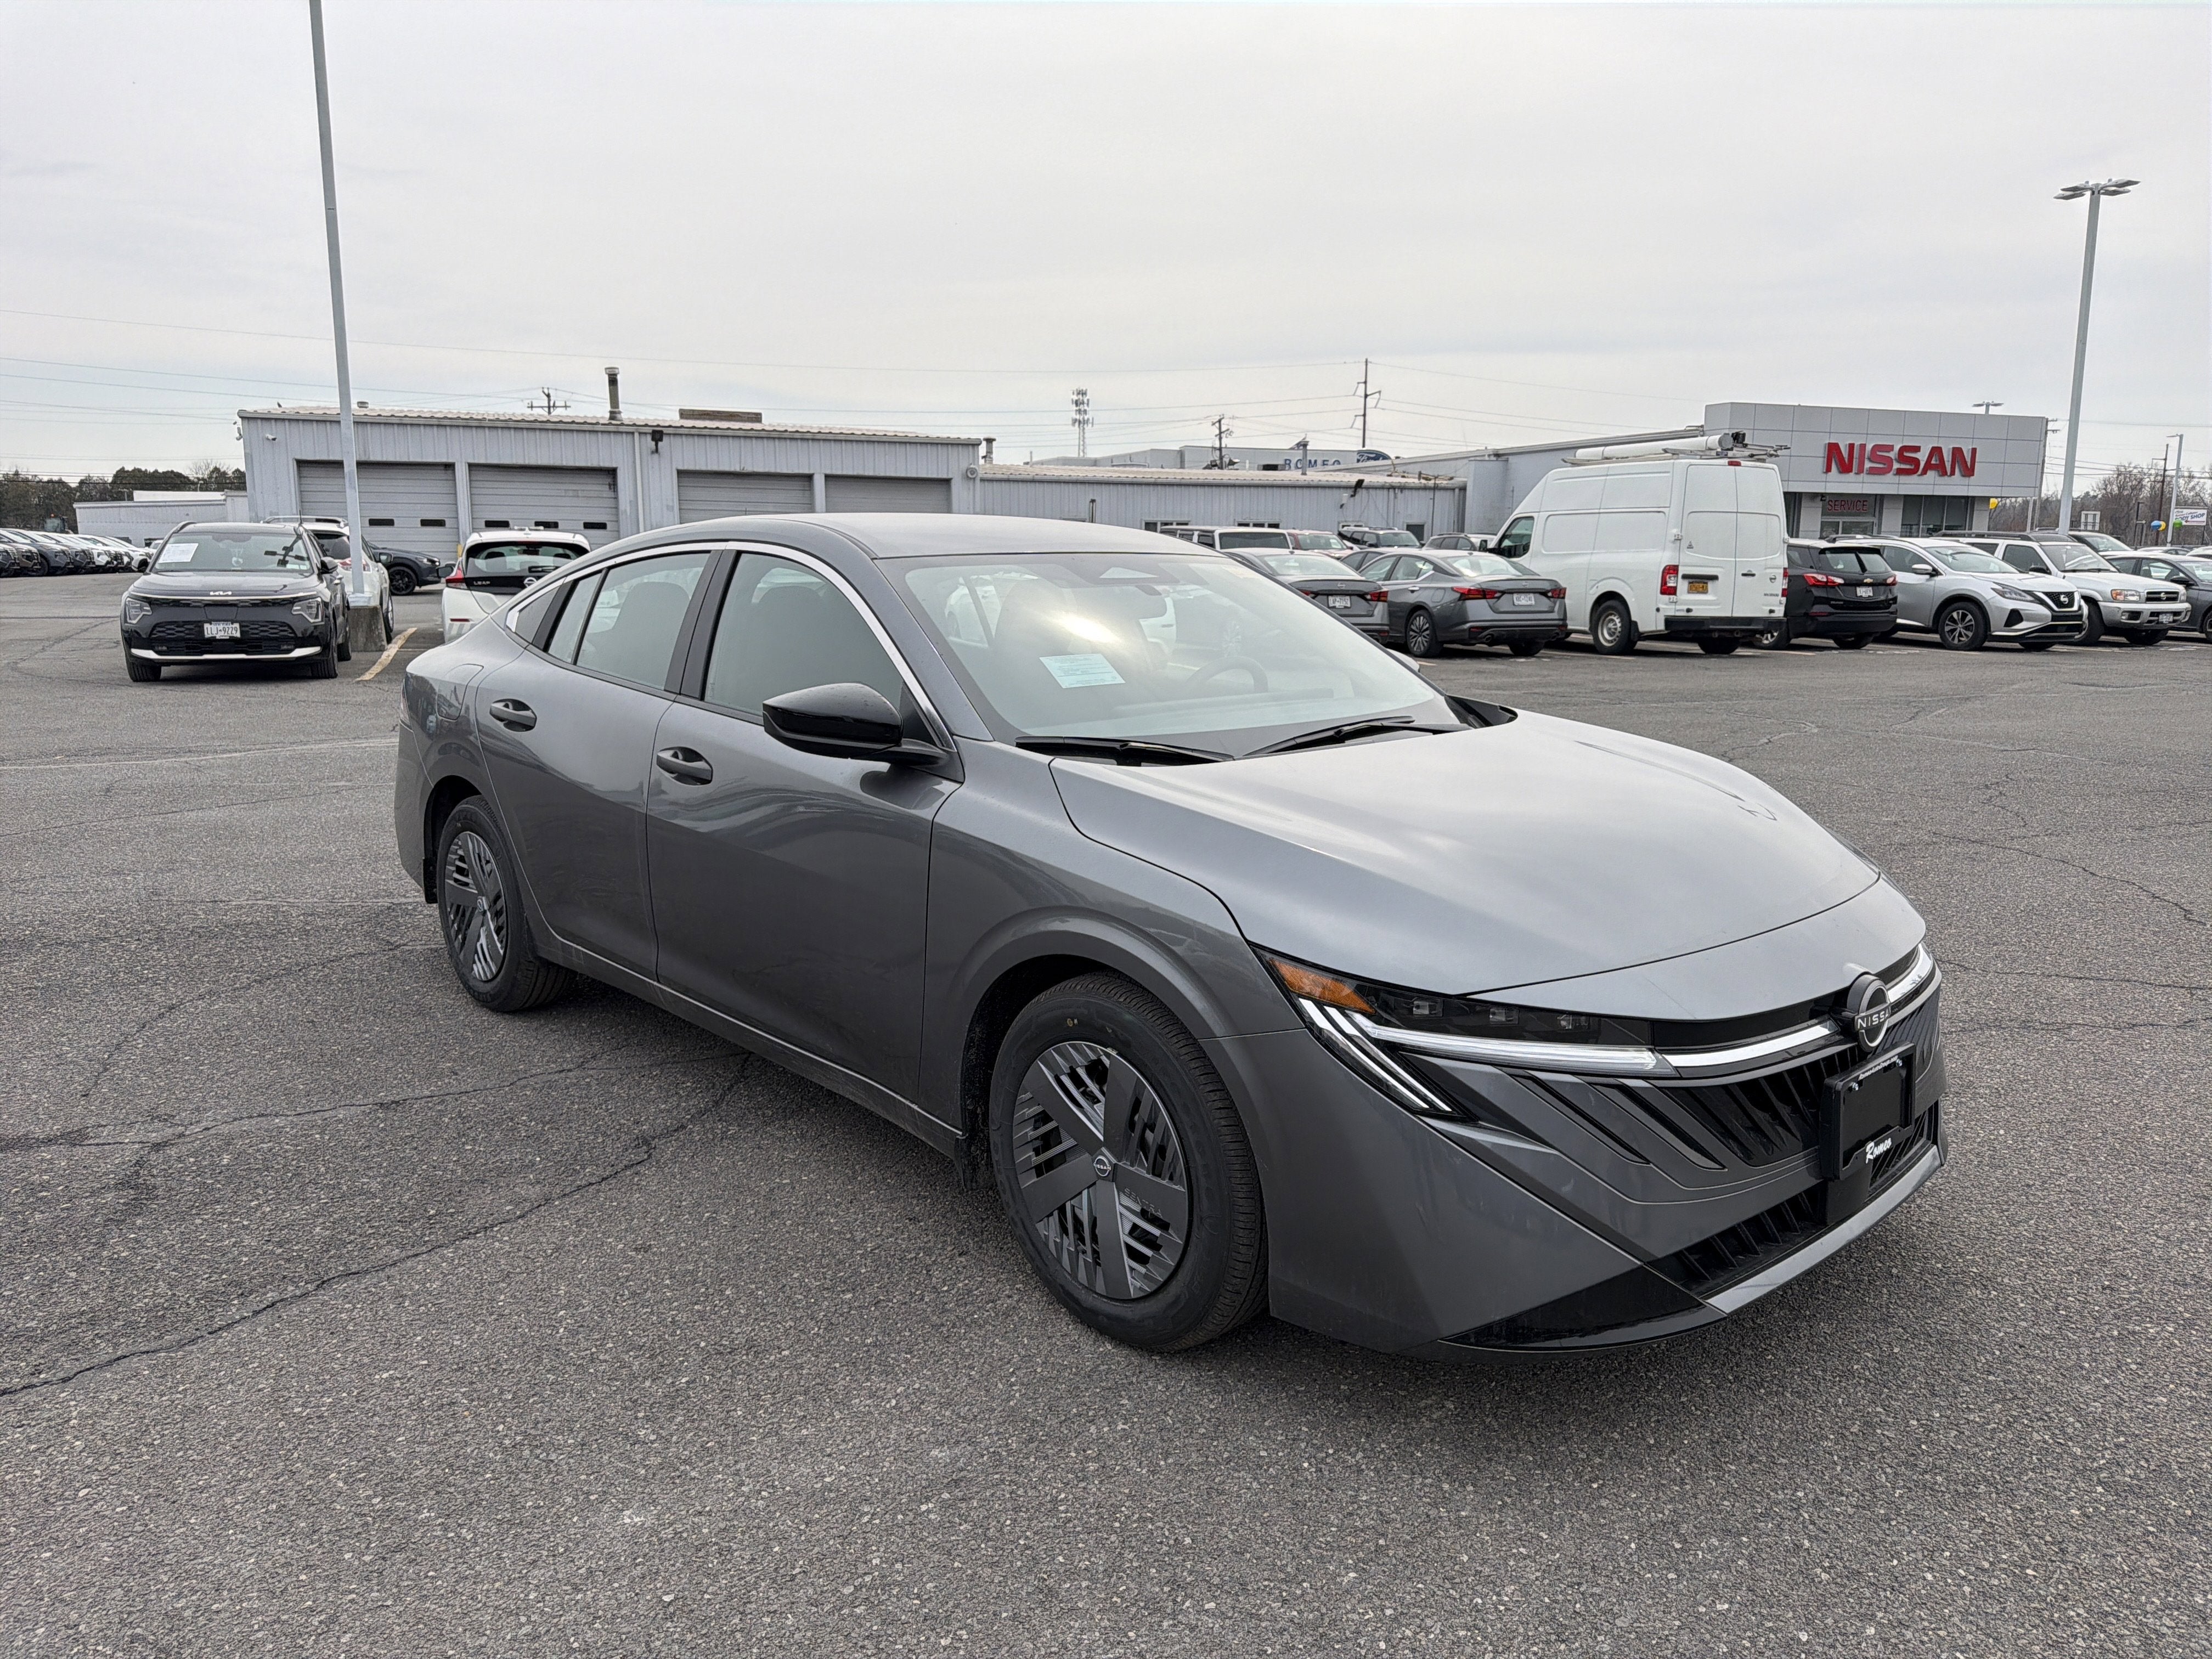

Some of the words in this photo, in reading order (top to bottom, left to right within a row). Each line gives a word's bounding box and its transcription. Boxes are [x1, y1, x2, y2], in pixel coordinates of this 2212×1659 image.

[1825, 442, 1977, 477] NISSAN
[1827, 500, 1868, 512] SERVICE
[1858, 1008, 1889, 1029] NISSA
[1865, 1137, 1892, 1164] Romeo
[1124, 1188, 1163, 1218] SENTRA
